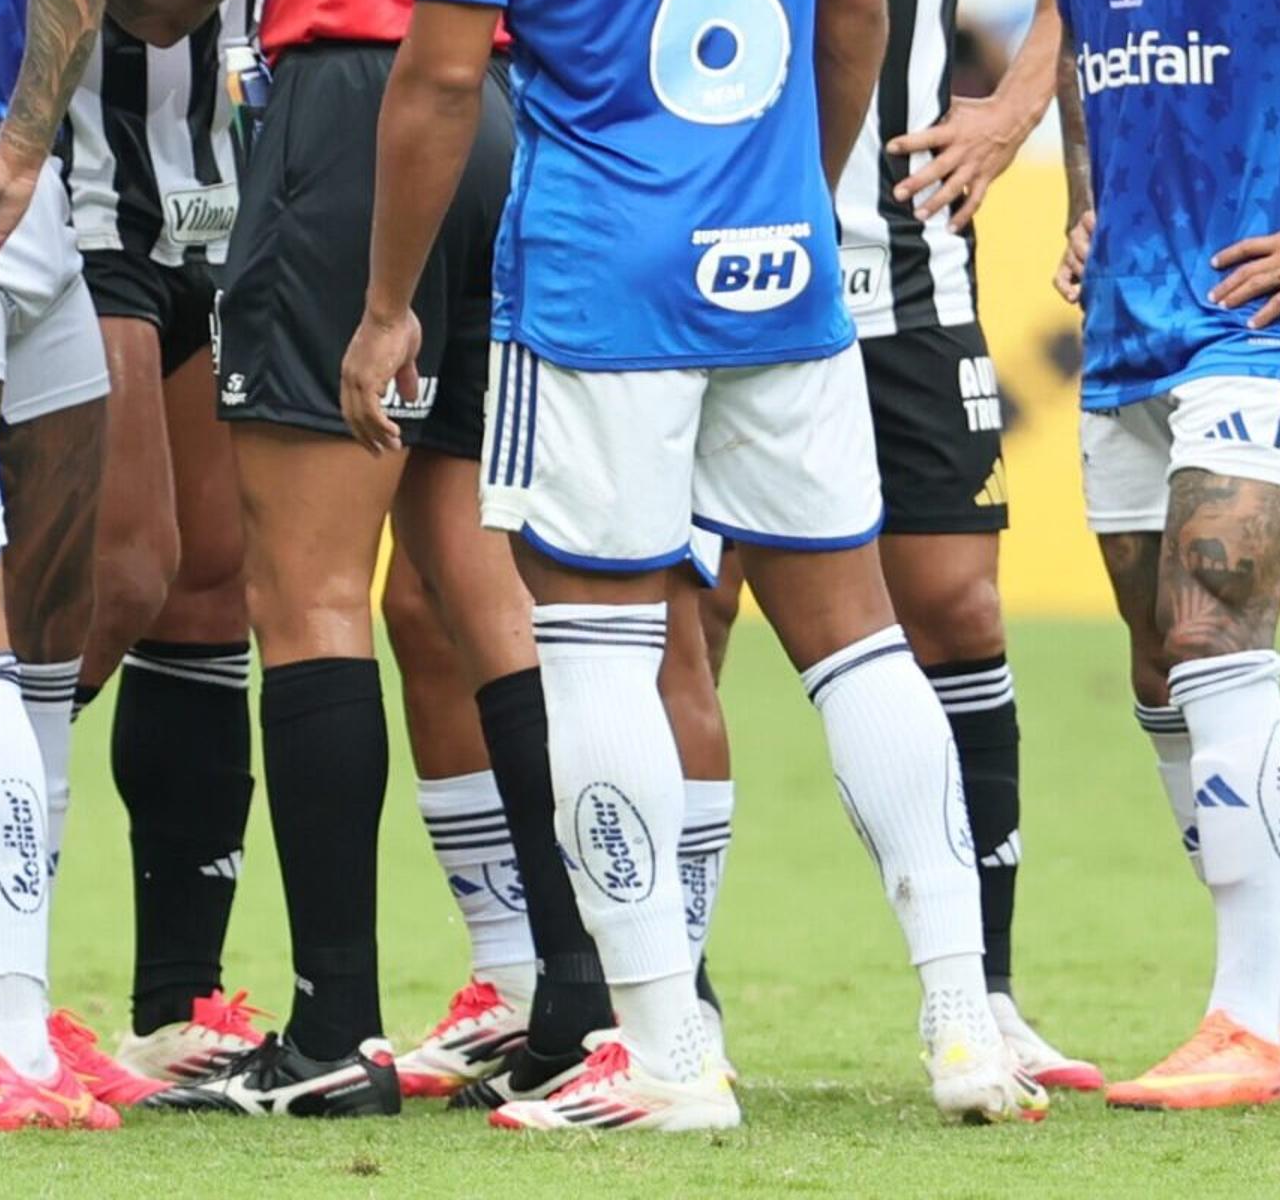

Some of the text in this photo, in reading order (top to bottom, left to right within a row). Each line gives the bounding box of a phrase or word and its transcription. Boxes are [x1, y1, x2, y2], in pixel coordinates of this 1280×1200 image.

[1082, 30, 1231, 95] betfair
[173, 197, 236, 232] Vilma
[711, 250, 796, 294] BH
[3, 790, 41, 897] Kodilar
[588, 793, 643, 890] Kodilar
